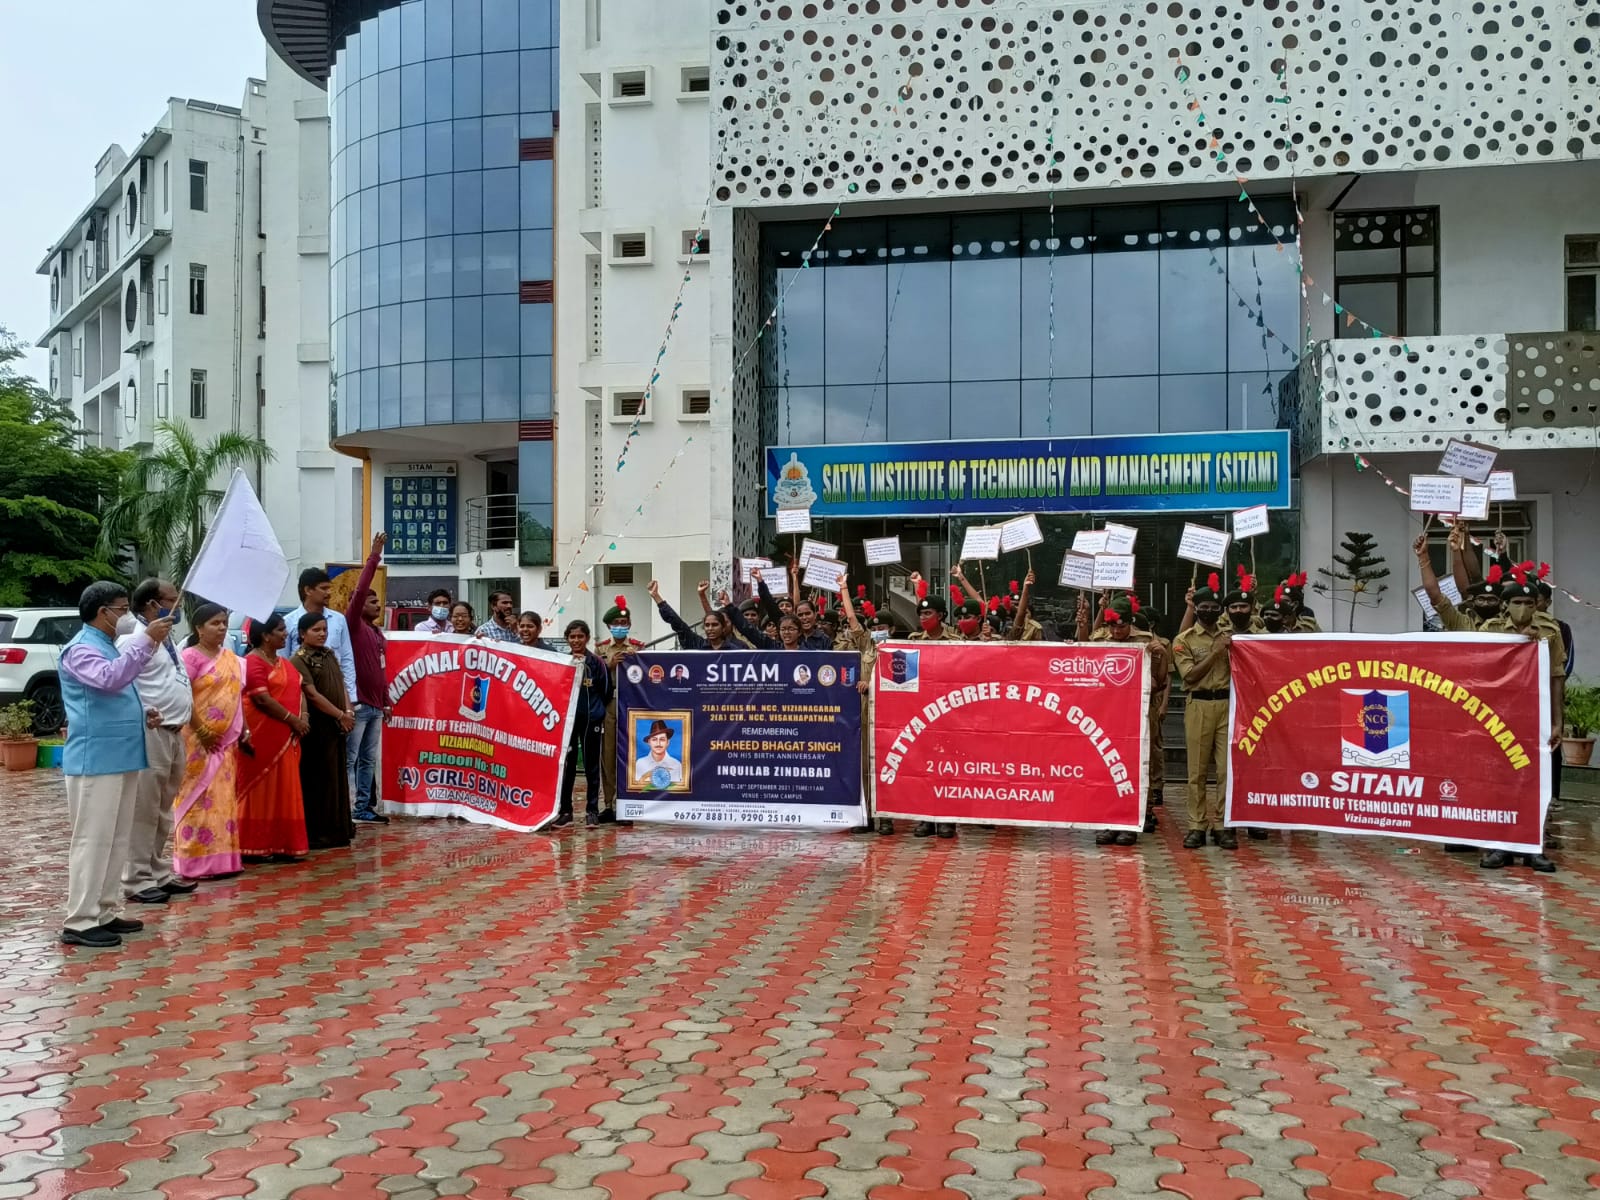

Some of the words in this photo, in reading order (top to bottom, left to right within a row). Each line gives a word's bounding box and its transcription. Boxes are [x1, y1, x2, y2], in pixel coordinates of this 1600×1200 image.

[408, 463, 432, 471] SITAM
[823, 464, 866, 502] SATYA
[870, 461, 944, 502] INSTITUTE
[949, 459, 967, 500] OF
[970, 457, 1066, 498] TECHNOLOGY
[1070, 456, 1101, 496] AND
[1105, 453, 1212, 496] MANAGEMENT
[1215, 451, 1279, 494] (SITAM)
[706, 663, 779, 682] SITAM
[1049, 656, 1118, 677] sathya
[388, 650, 461, 704] NATIONAL
[464, 648, 516, 683] CADET
[512, 670, 561, 731] CORPS
[1306, 662, 1352, 689] NCC
[1356, 660, 1531, 770] VISAKHAPATNAM
[1364, 713, 1388, 725] NCC
[436, 719, 448, 732] OF
[450, 720, 496, 741] TECHNOLOGY
[494, 729, 508, 745] AND
[507, 733, 557, 757] MANAGEMENT
[741, 727, 799, 736] REMEMBERING
[880, 716, 927, 784] SATYA
[922, 682, 1001, 723] DEGREE
[1005, 684, 1021, 700] &
[1025, 685, 1061, 715] P.G.
[1066, 705, 1135, 798] COLLEGE
[710, 740, 760, 751] SHAHEED
[761, 741, 805, 751] BHAGAT
[807, 741, 841, 752] SINGH
[754, 752, 774, 760] BIRTH
[419, 751, 473, 767] Platoon
[475, 757, 489, 773] No:
[717, 765, 770, 777] INQUILAB
[774, 766, 831, 778] ZINDABAD
[926, 760, 934, 772] 2
[938, 761, 959, 776] (A)
[963, 762, 1015, 775] GIRL'S
[1020, 763, 1045, 778] Bn,
[1050, 764, 1084, 778] NCC
[424, 768, 475, 790] GIRLS
[478, 775, 497, 798] BN
[499, 782, 533, 809] NCC
[933, 785, 1055, 803] VIZIANAGARAM
[1329, 771, 1425, 798] SITAM
[426, 787, 497, 813] VIZIANAGARAM
[1247, 791, 1278, 807] SATYA
[1280, 793, 1331, 809] INSTITUTE
[1333, 797, 1346, 810] OF
[1347, 798, 1414, 816] TECHNOLOGY
[1416, 803, 1439, 818] AND
[1441, 804, 1519, 824] MANAGEMENT
[673, 811, 702, 821] 96767
[741, 813, 764, 822] 9290
[767, 814, 802, 824] 251491
[1344, 812, 1412, 828] Vizianagaram
